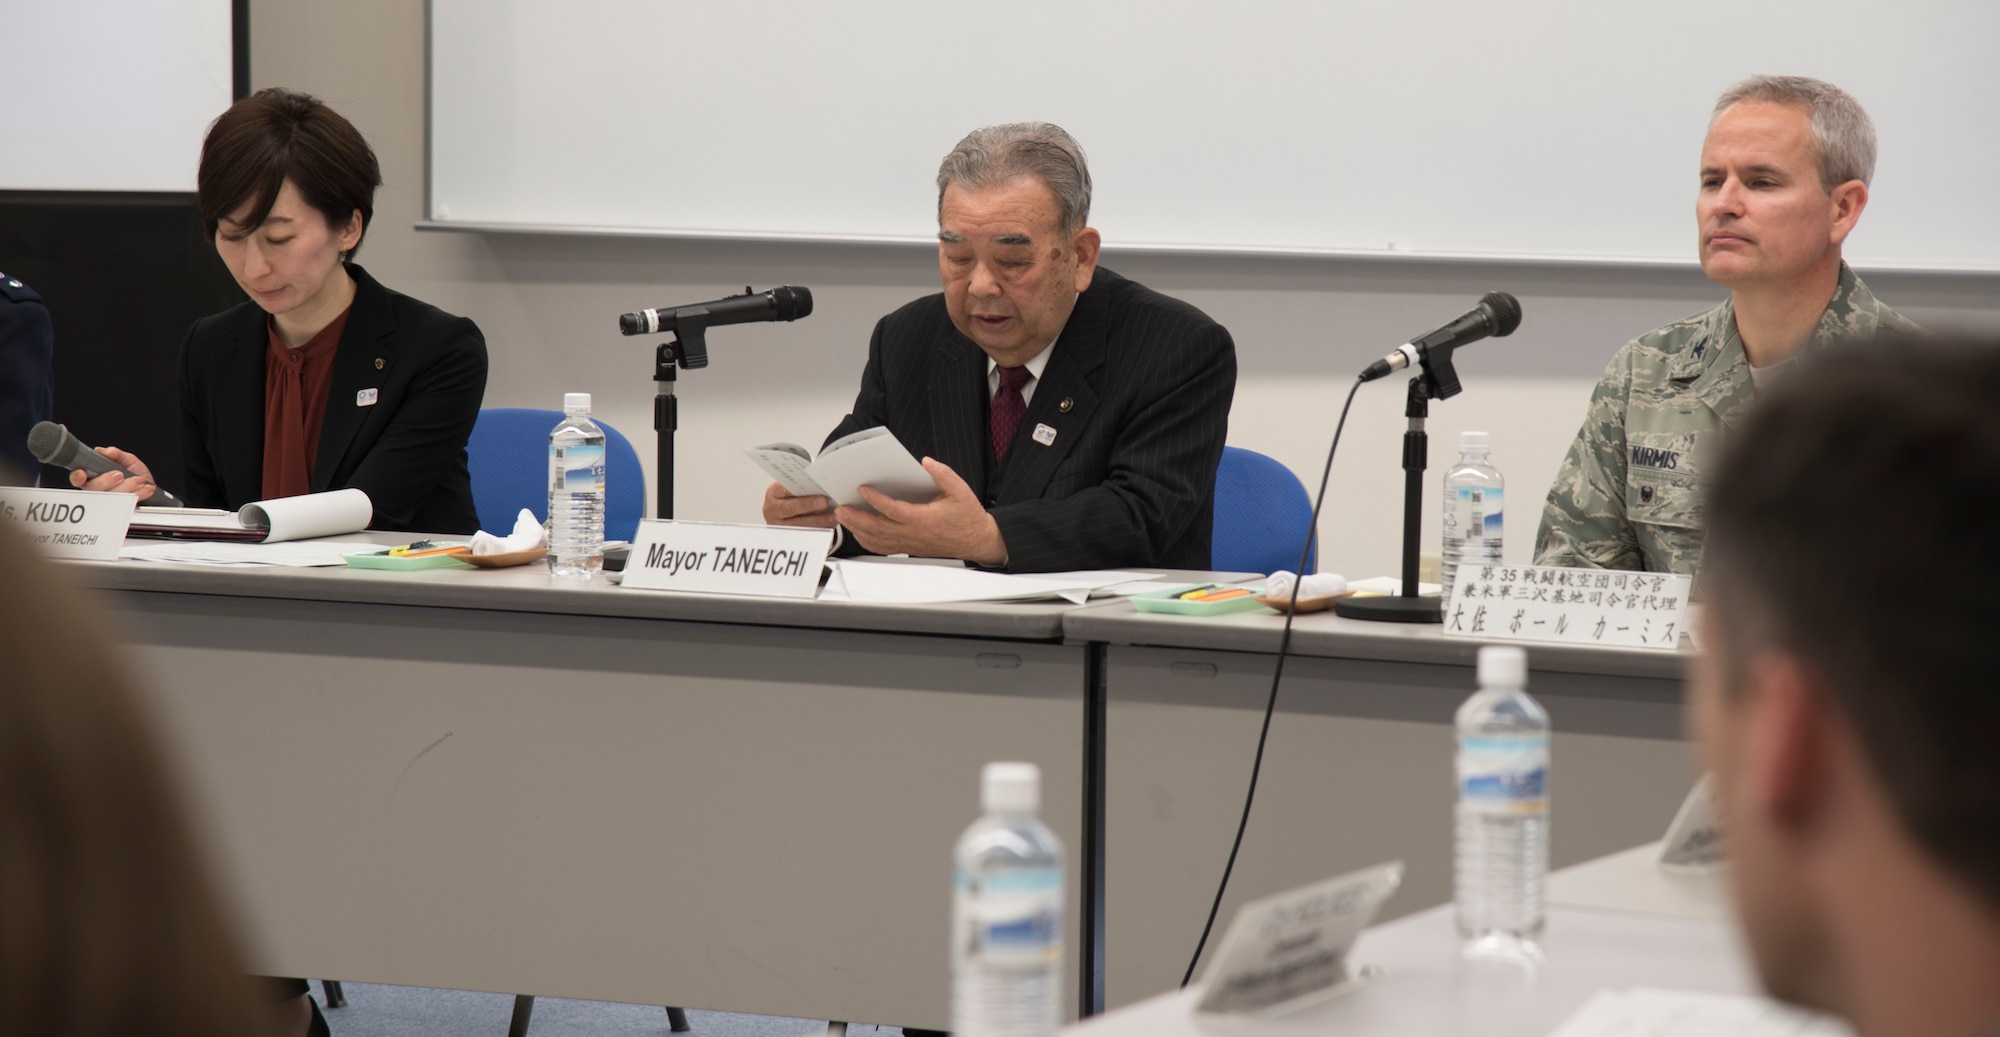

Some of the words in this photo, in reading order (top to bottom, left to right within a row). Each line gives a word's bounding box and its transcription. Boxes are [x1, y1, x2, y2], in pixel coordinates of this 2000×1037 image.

[1632, 446, 1680, 470] KIRMIS
[25, 502, 85, 523] KUDO
[52, 533, 98, 546] TANEICHI
[644, 542, 707, 576] Mayor
[712, 546, 809, 577] TANEICHI
[1448, 602, 1488, 633] 大佐
[1591, 615, 1676, 643] カーミス
